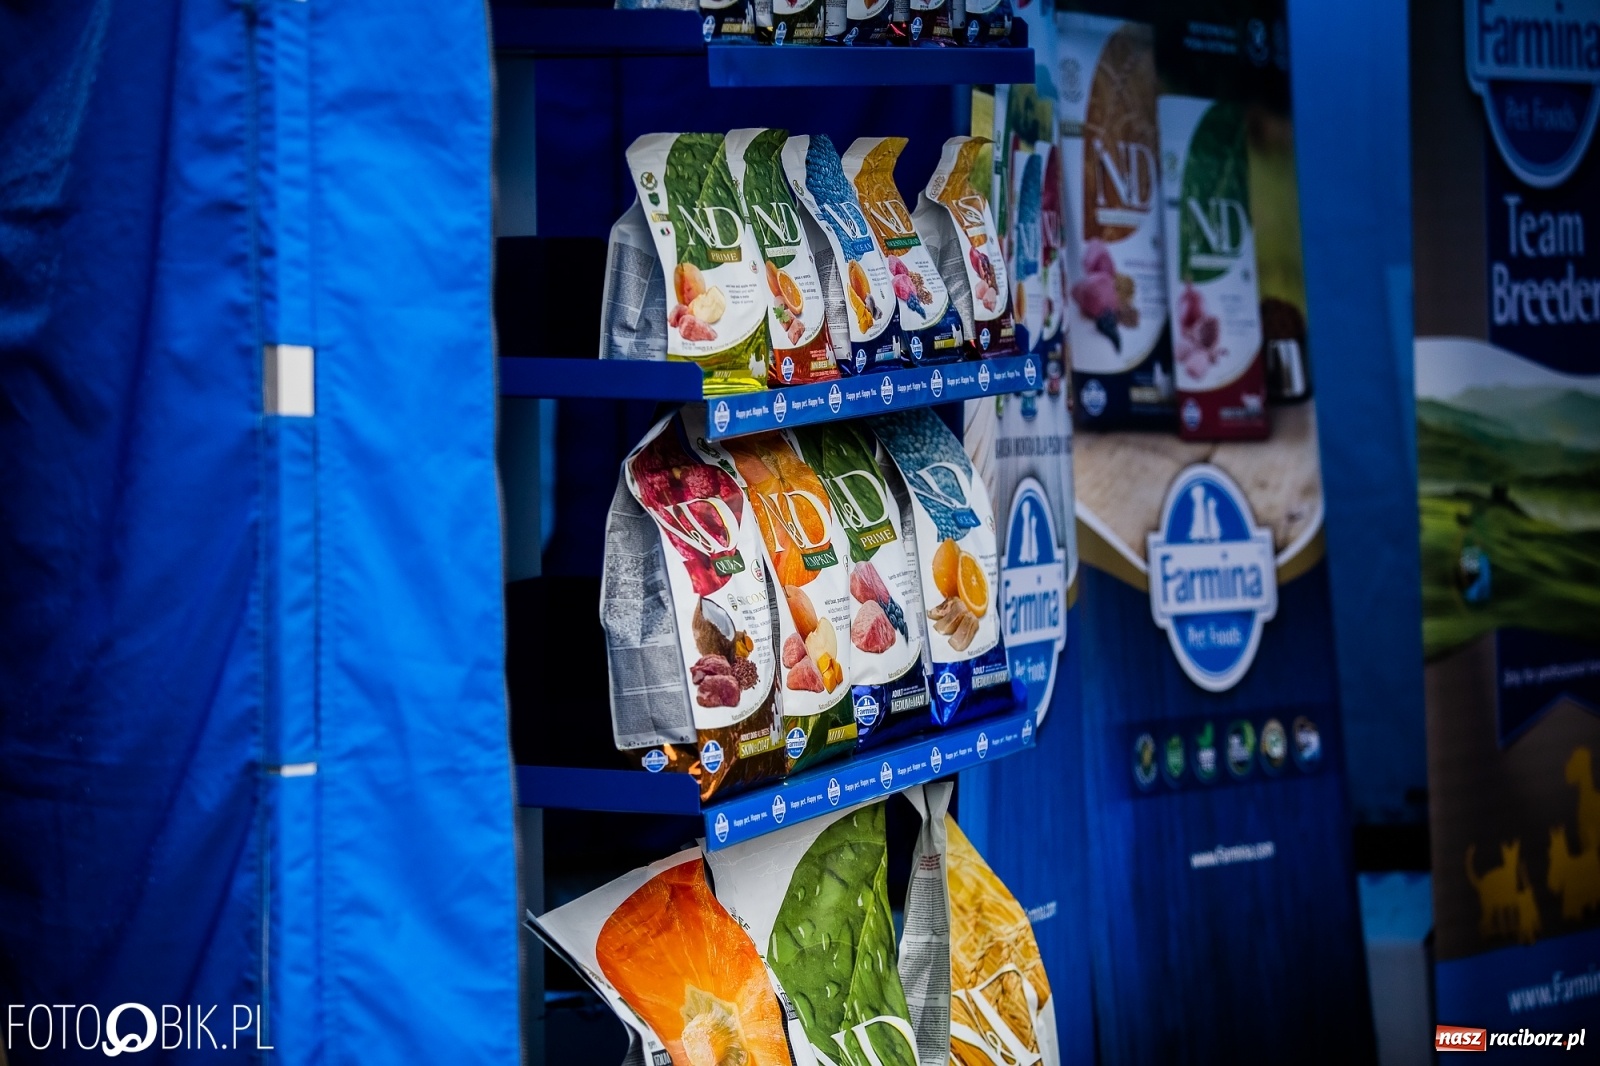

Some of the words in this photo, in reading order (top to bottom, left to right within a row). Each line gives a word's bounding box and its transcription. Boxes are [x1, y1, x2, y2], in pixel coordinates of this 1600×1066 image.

[1478, 2, 1600, 68] Farmina
[677, 204, 745, 249] N&D
[752, 202, 802, 246] N&D
[864, 200, 916, 237] N&D
[1504, 195, 1584, 256] Team
[711, 252, 738, 261] PRIME
[714, 370, 731, 378] MINI
[817, 470, 889, 532] N&D
[647, 497, 741, 557] N&D
[757, 490, 833, 553] N&D
[860, 529, 893, 547] PRIME
[1160, 553, 1263, 605] Farmina
[1004, 575, 1059, 636] Farmina
[1188, 626, 1204, 645] Pet
[973, 665, 985, 675] ADULT
[892, 688, 904, 698] ADULT
[856, 705, 878, 715] Farmina
[786, 739, 806, 749] Farmina
[829, 728, 845, 741] MINI
[702, 753, 722, 763] Farmina
